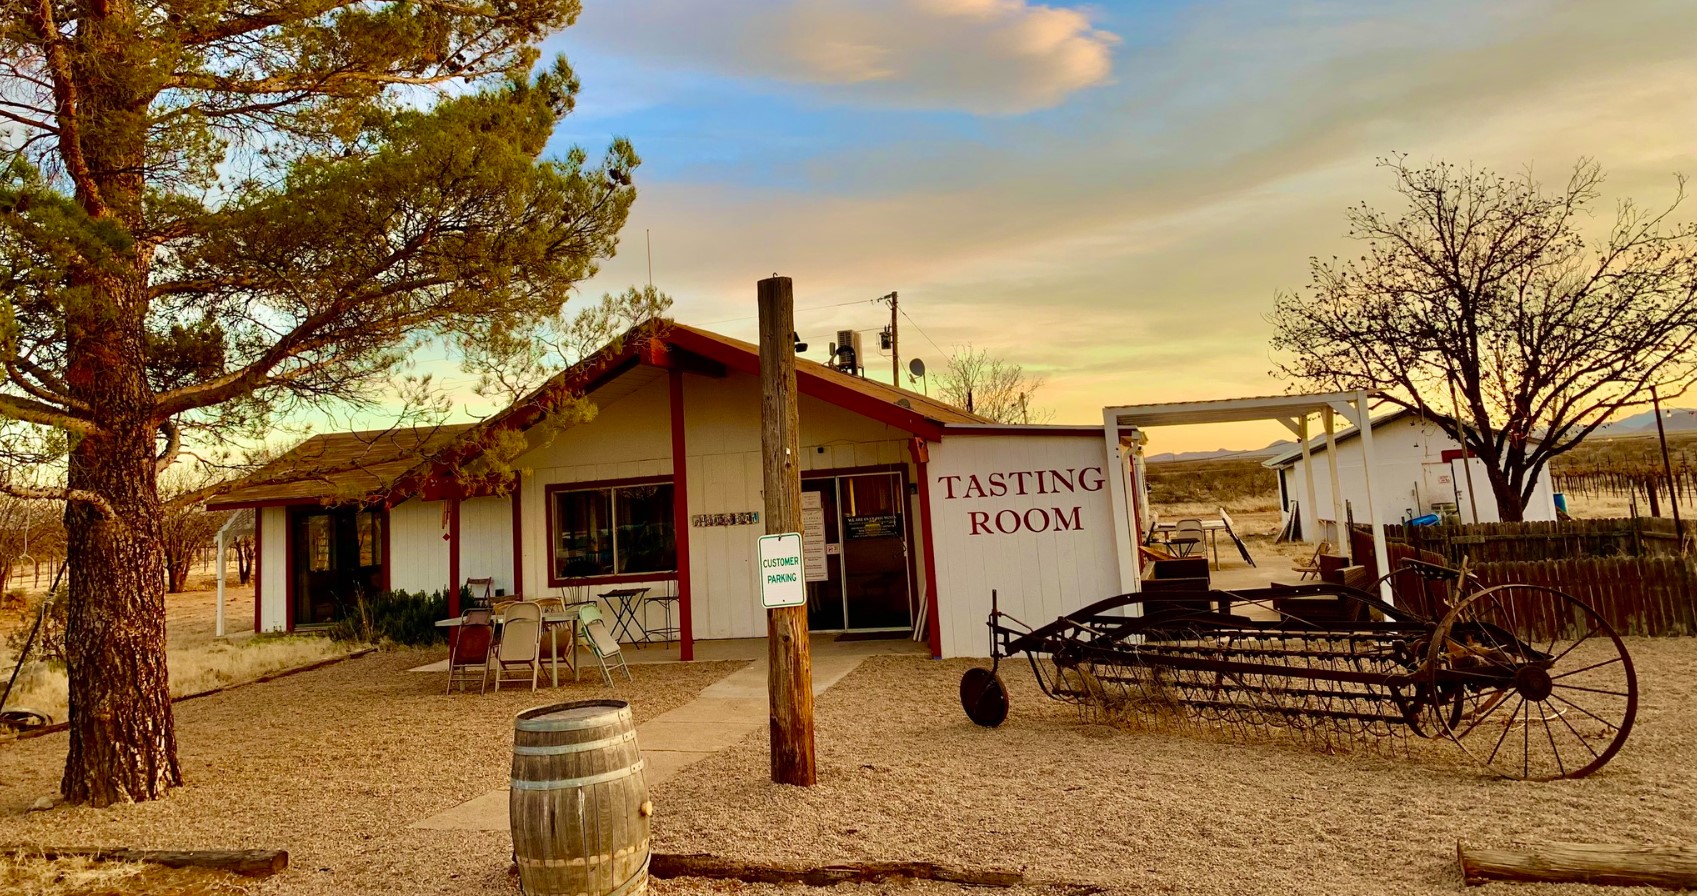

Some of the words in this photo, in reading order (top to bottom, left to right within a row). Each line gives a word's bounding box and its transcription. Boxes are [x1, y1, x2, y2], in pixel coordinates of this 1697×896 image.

[937, 467, 1106, 500] TASTING
[967, 506, 1085, 536] ROOM
[762, 556, 799, 568] CUSTOMER
[767, 572, 797, 584] PARKING
